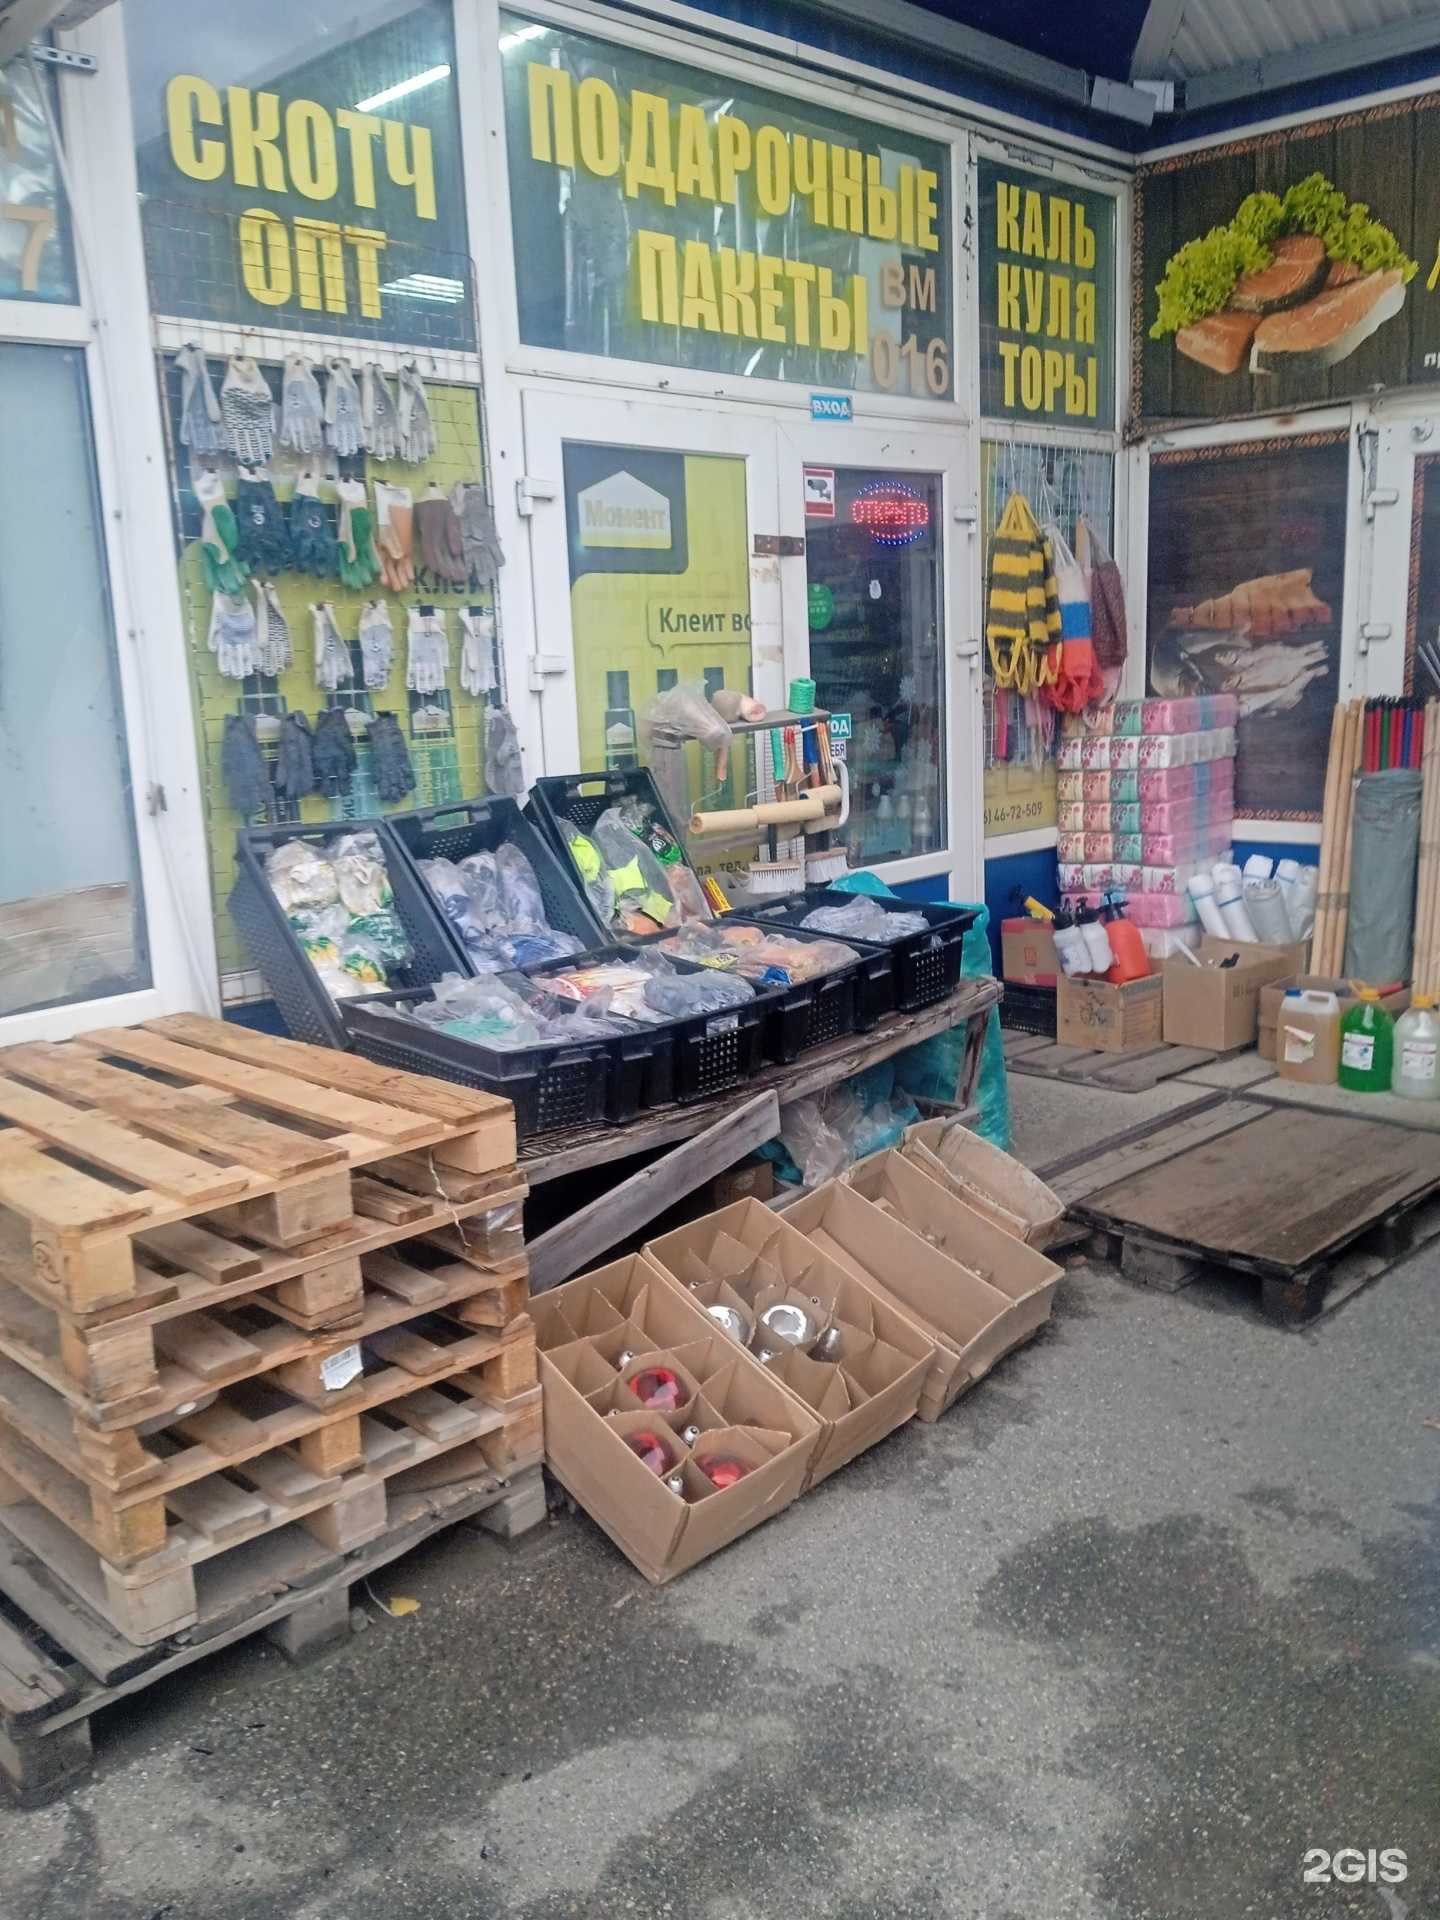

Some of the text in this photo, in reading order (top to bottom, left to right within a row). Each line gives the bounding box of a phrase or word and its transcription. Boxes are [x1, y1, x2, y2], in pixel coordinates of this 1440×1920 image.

[166, 74, 437, 220] СКОТЧ
[527, 62, 939, 251] ПОДАРОЧНЫЕ
[996, 181, 1095, 269] КАЛЬ
[239, 208, 386, 319] ОПТ
[637, 228, 868, 355] ПАКЕТЫ
[882, 261, 936, 313] ВМ
[997, 262, 1095, 344] КУЛЯ
[872, 329, 949, 396] 016
[999, 341, 1097, 417] ТОРЫ
[812, 399, 849, 417] ВХОД
[584, 499, 665, 529] Момент
[852, 499, 928, 525] ОТКРЫТО
[659, 607, 726, 633] Клеит
[826, 719, 849, 735] ОД
